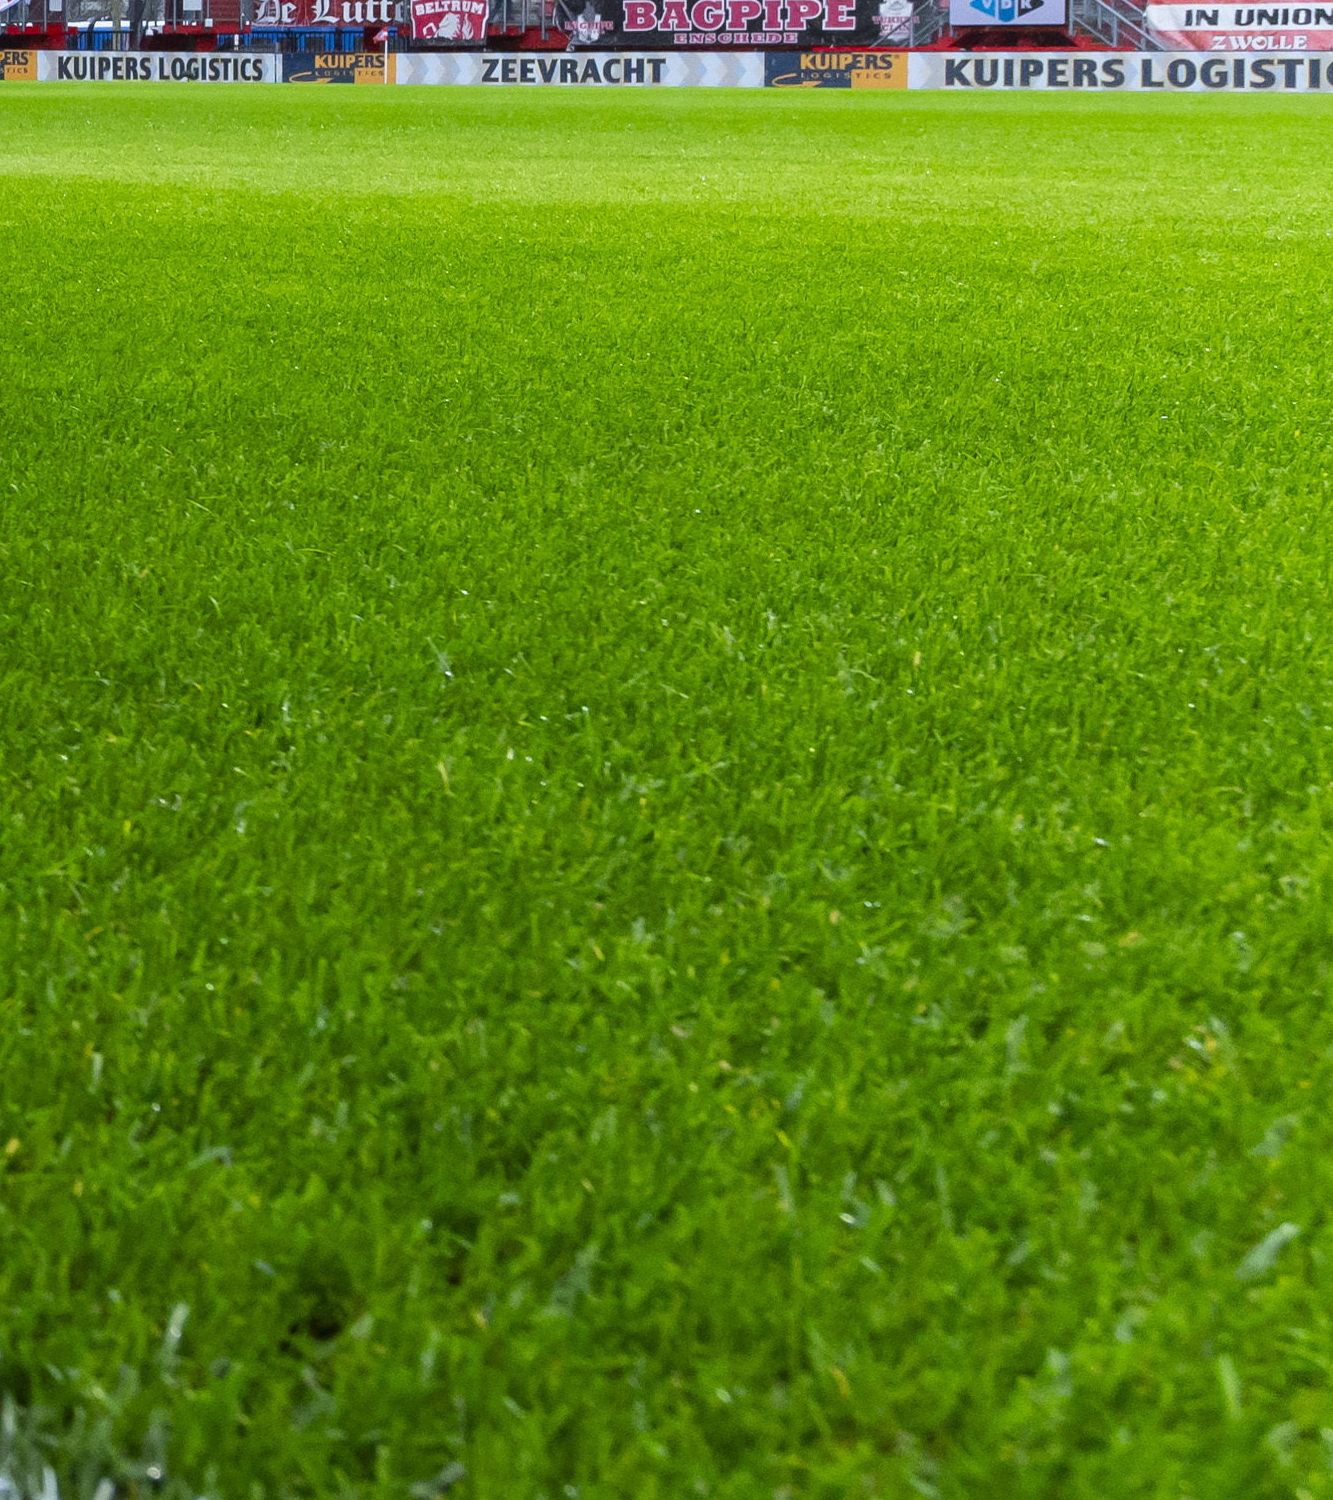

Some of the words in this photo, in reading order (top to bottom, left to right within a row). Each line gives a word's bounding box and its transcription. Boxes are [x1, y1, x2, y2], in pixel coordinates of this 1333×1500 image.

[415, 0, 484, 17] BELTRUM
[1185, 9, 1219, 27] IN
[674, 32, 798, 44] ENSCHEDE
[1211, 35, 1308, 50] ZWOLLE
[57, 55, 151, 81] KUIPERS
[159, 57, 263, 82] LOGISTICS
[315, 54, 385, 69] KUIPERS
[800, 54, 893, 70] KUIPERS
[482, 59, 667, 84] ZEEVRACHT
[945, 58, 1125, 88] KUIPERS
[1141, 58, 1333, 90] LOGISTIC
